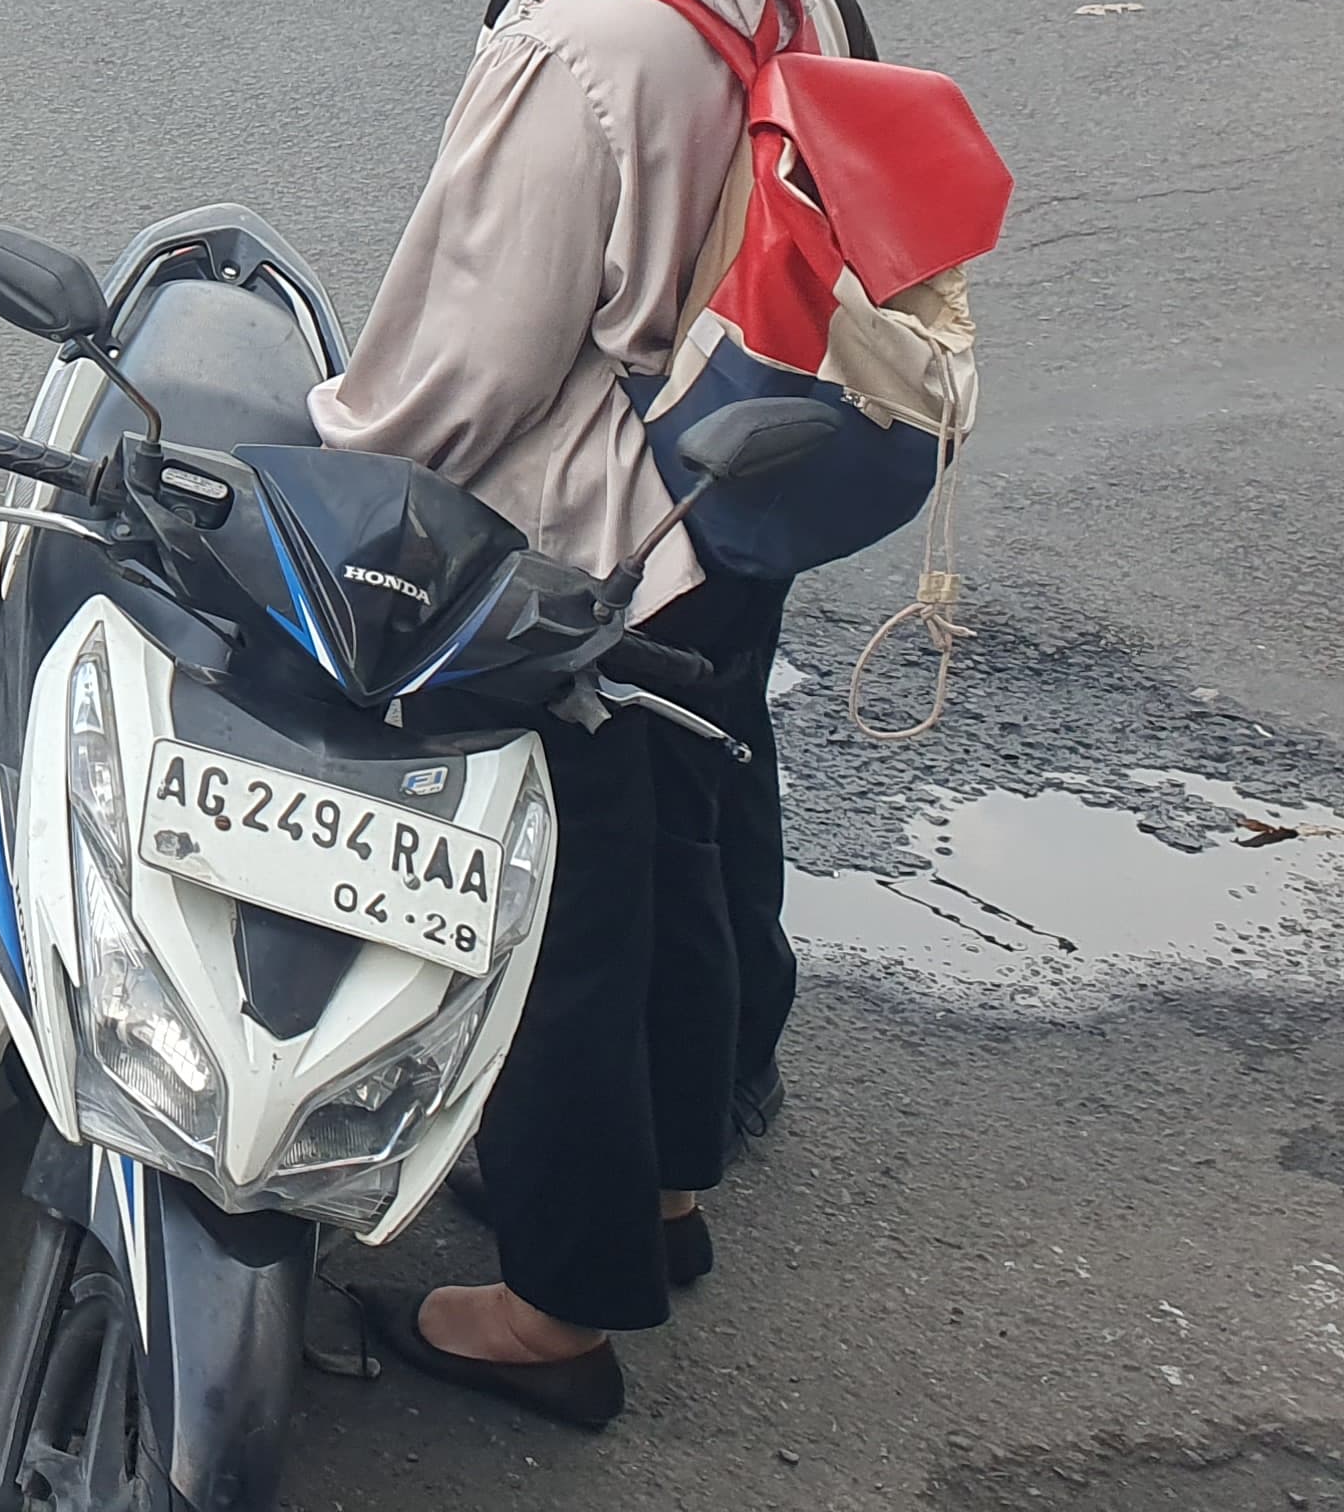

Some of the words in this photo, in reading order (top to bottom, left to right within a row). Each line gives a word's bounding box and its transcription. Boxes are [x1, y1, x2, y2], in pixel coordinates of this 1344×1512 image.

[343, 565, 432, 606] HONDA
[157, 756, 231, 818] AG
[241, 781, 376, 861] 2494
[390, 822, 489, 904] RAA
